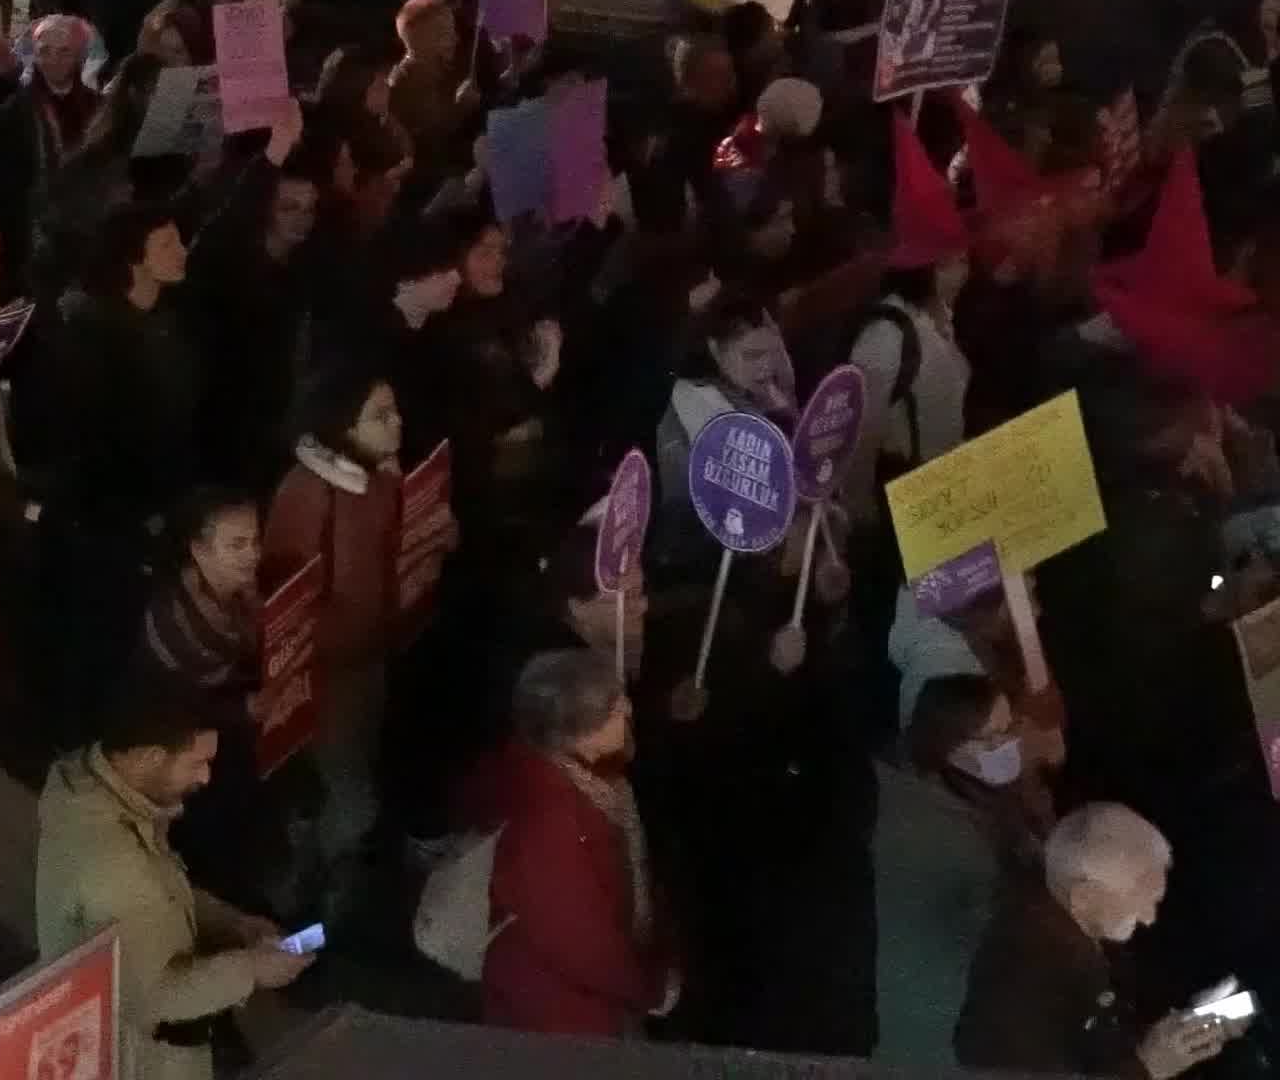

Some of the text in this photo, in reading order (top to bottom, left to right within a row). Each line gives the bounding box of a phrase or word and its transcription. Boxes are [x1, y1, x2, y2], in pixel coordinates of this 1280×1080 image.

[725, 427, 772, 460] KADIN
[704, 456, 779, 510] ÖZGÜRLÜK
[722, 444, 770, 484] YAŞAM
